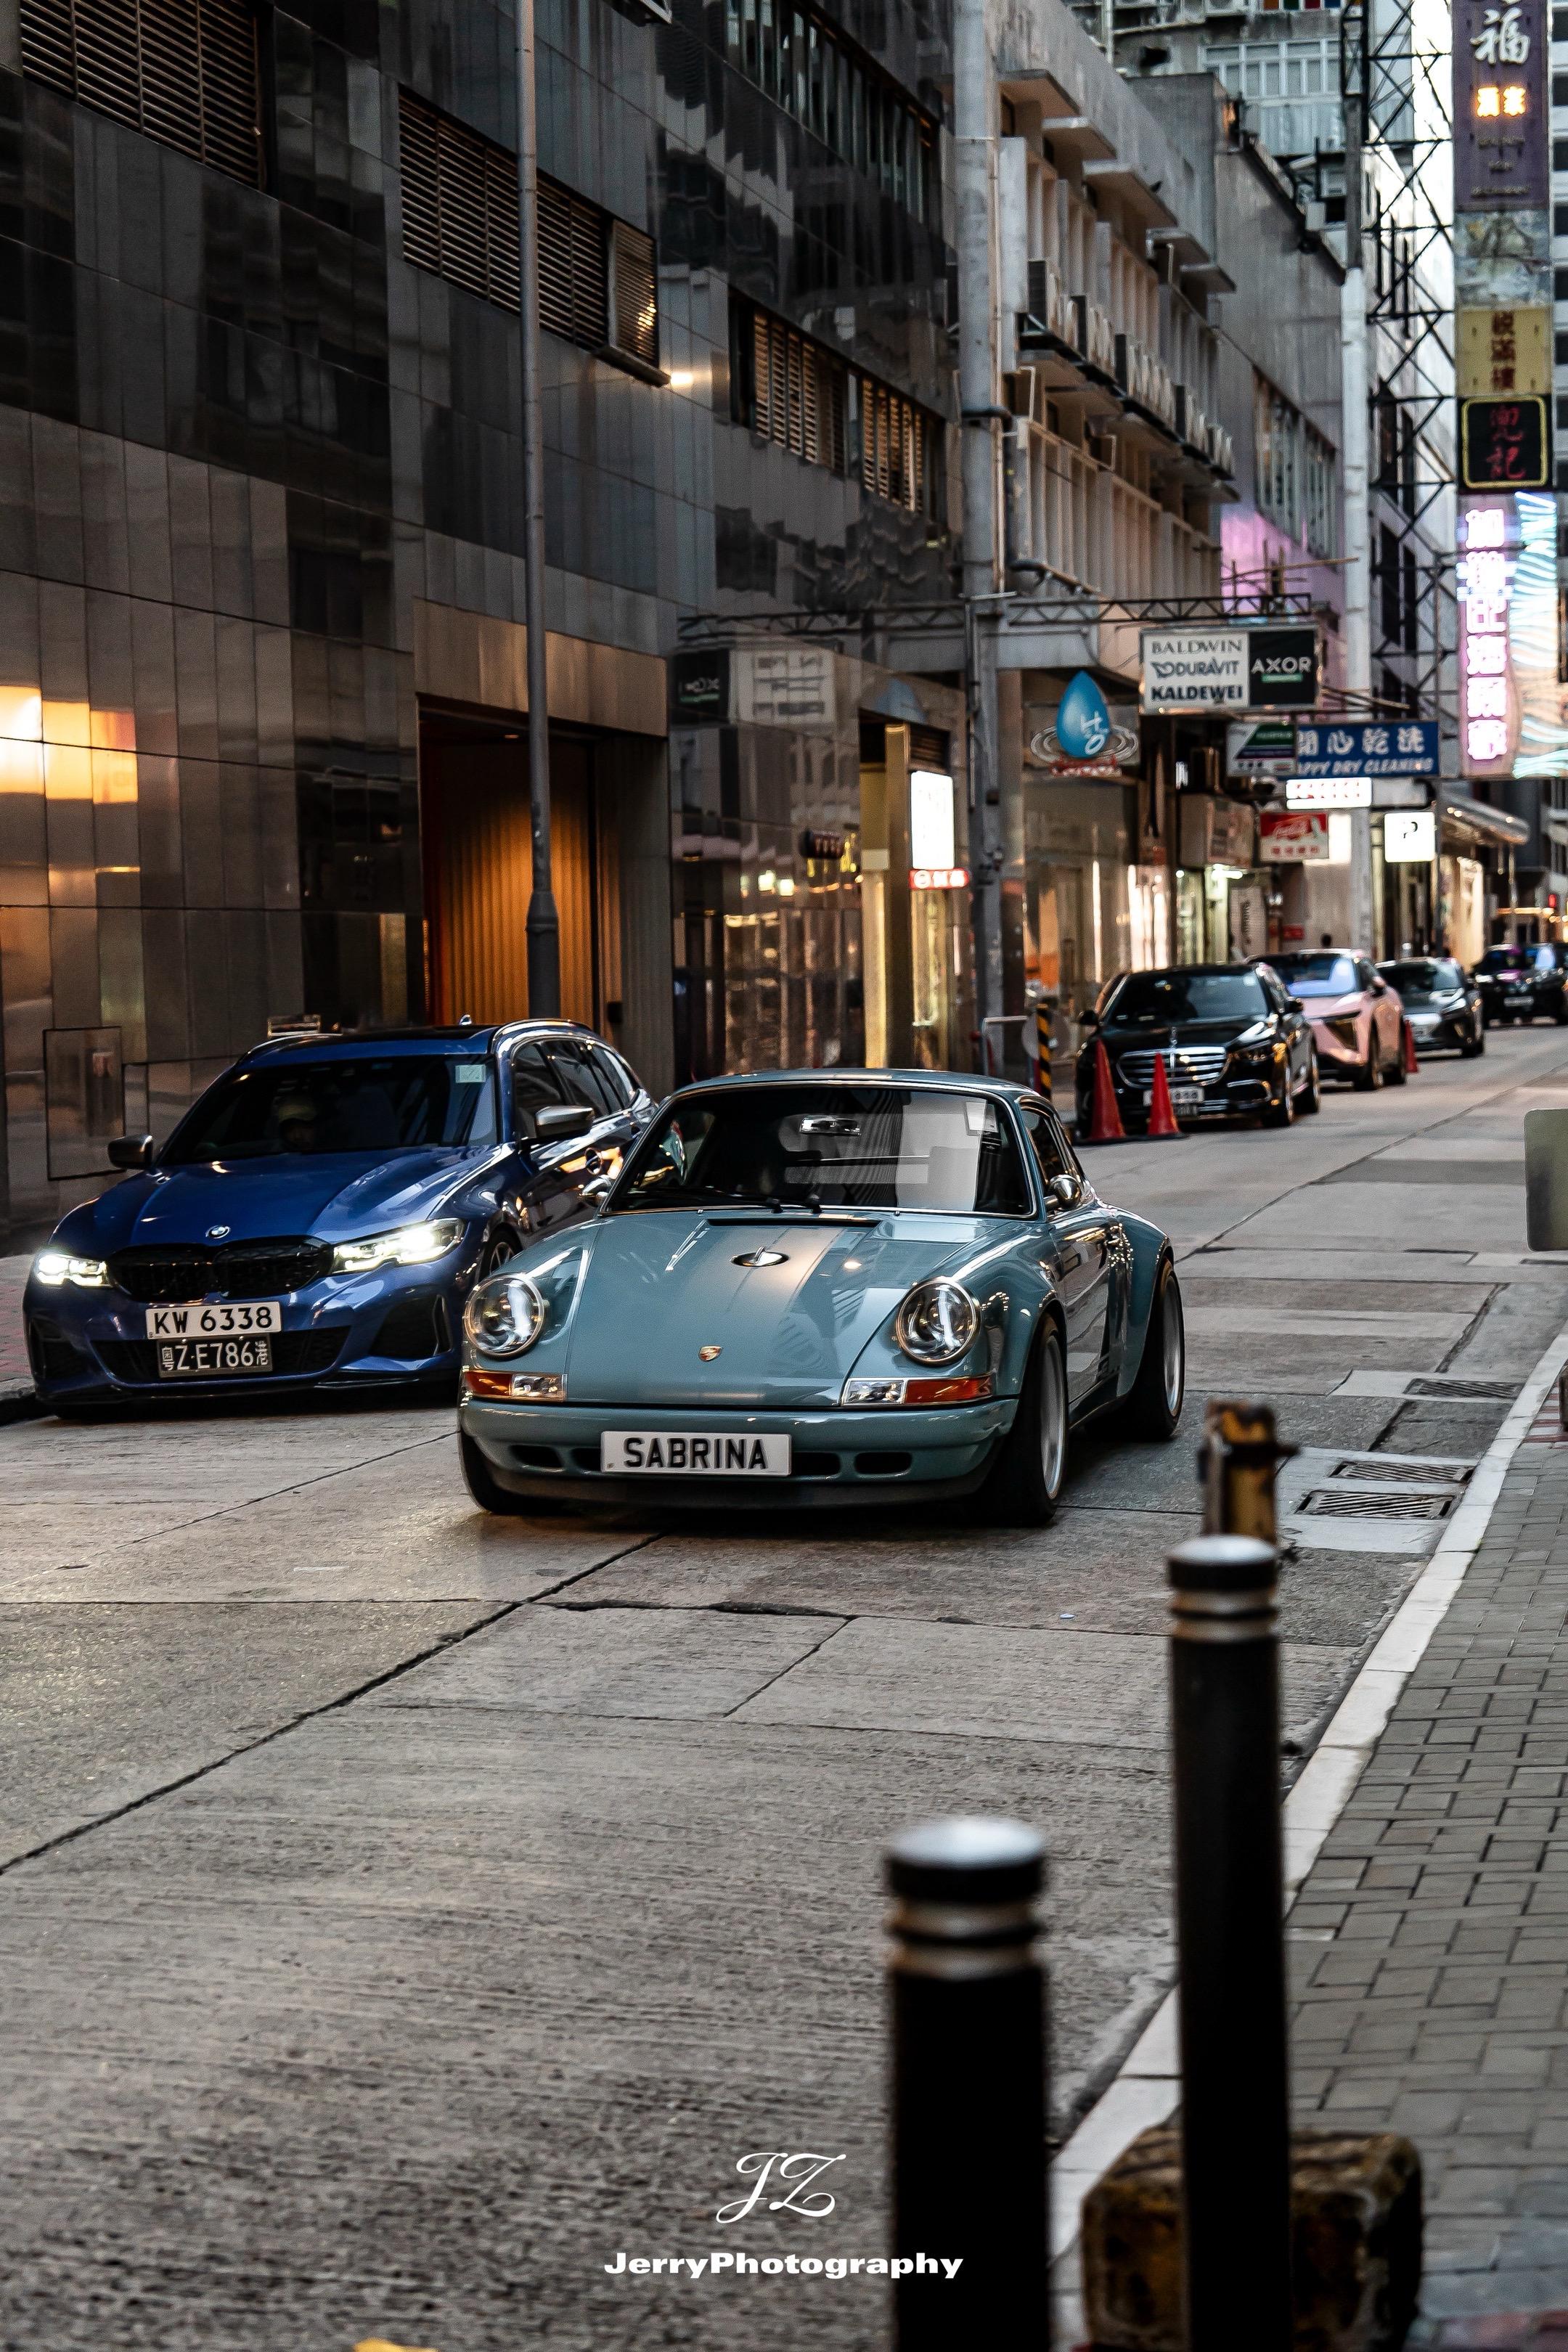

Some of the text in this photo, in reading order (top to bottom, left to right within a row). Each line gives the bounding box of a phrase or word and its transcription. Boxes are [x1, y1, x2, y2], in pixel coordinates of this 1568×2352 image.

[1469, 6, 1530, 65] 福
[1151, 639, 1242, 654] BALDWIN
[1175, 656, 1239, 676] DURAVIT
[1251, 656, 1312, 674] AXOR
[1151, 685, 1243, 701] KALDEWEI
[154, 1307, 272, 1334] KW 6338
[623, 1437, 768, 1469] SABRINA
